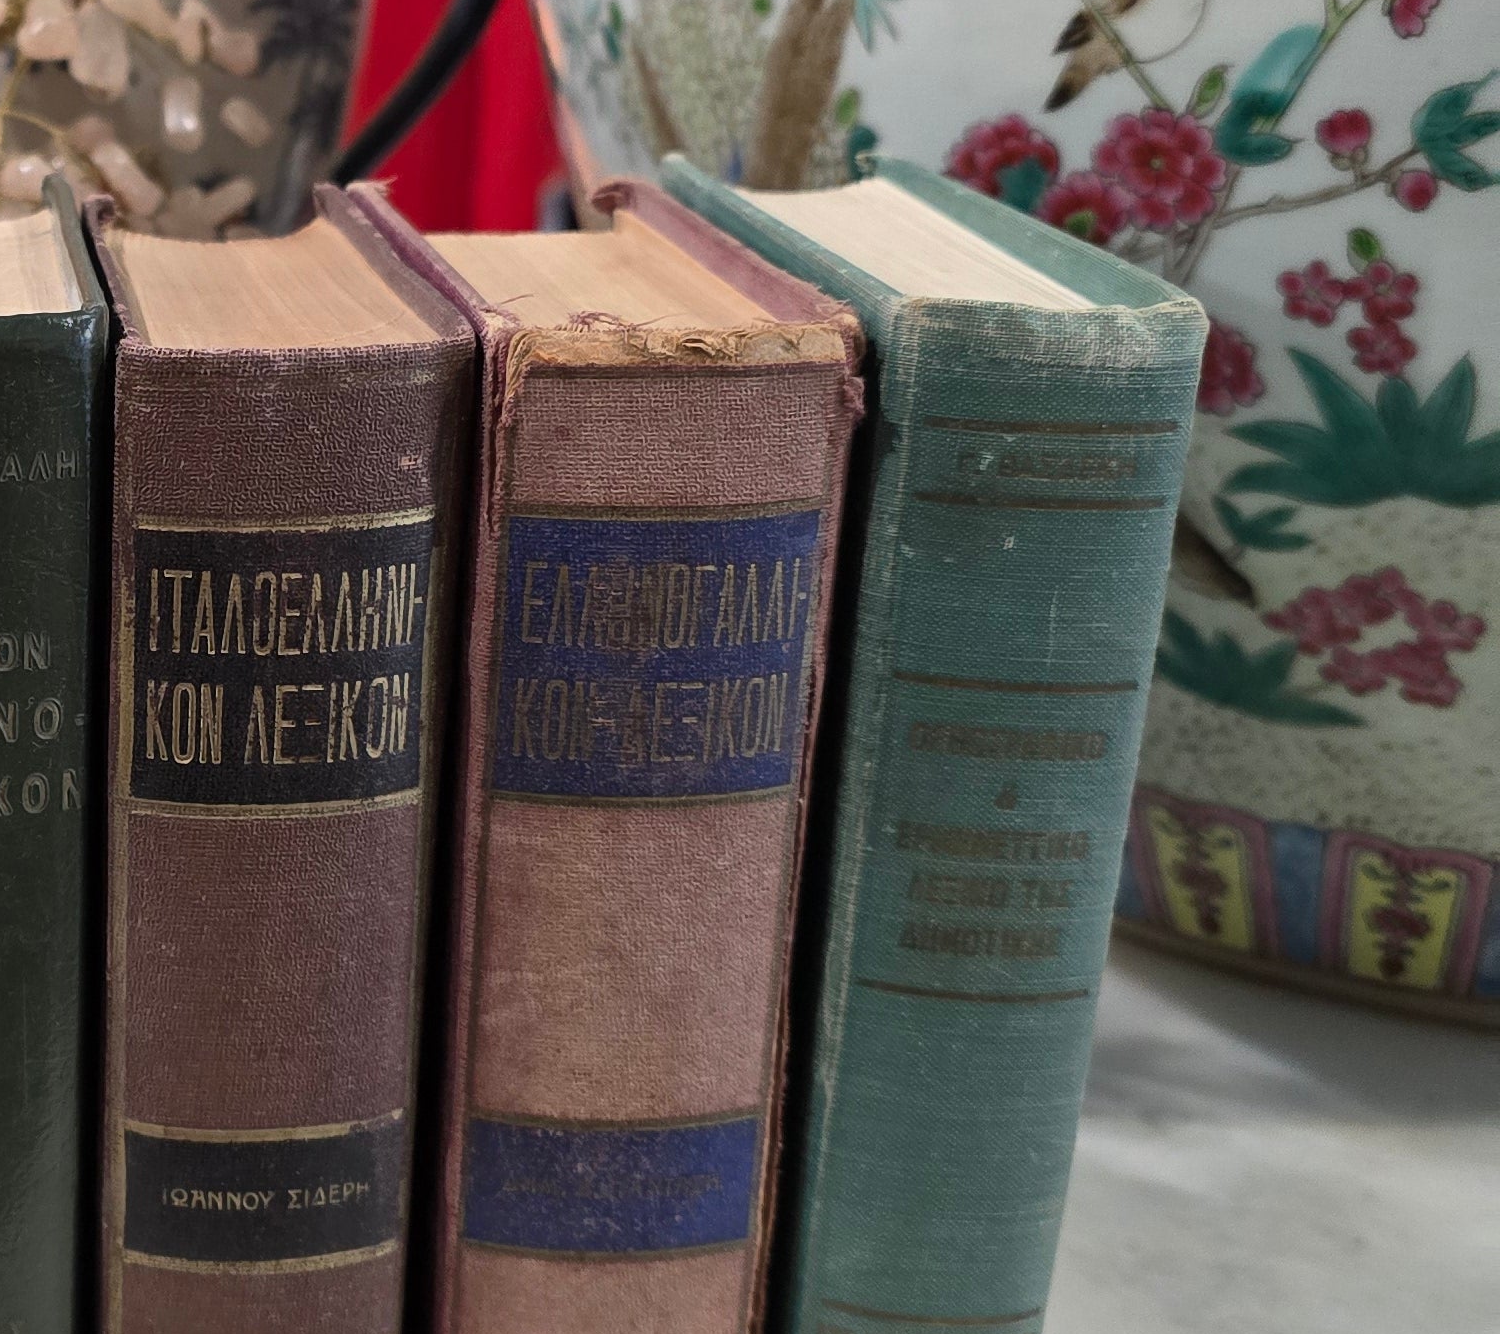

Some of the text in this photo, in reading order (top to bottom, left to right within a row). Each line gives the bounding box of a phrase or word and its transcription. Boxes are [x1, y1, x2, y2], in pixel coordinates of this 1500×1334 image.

[145, 671, 410, 766] ΚΟΝ ΛΕΞΙΚΟΝ
[161, 1179, 372, 1211] ΙΩΑΝΝΟΥ ΣΙΔΕΡΗ
